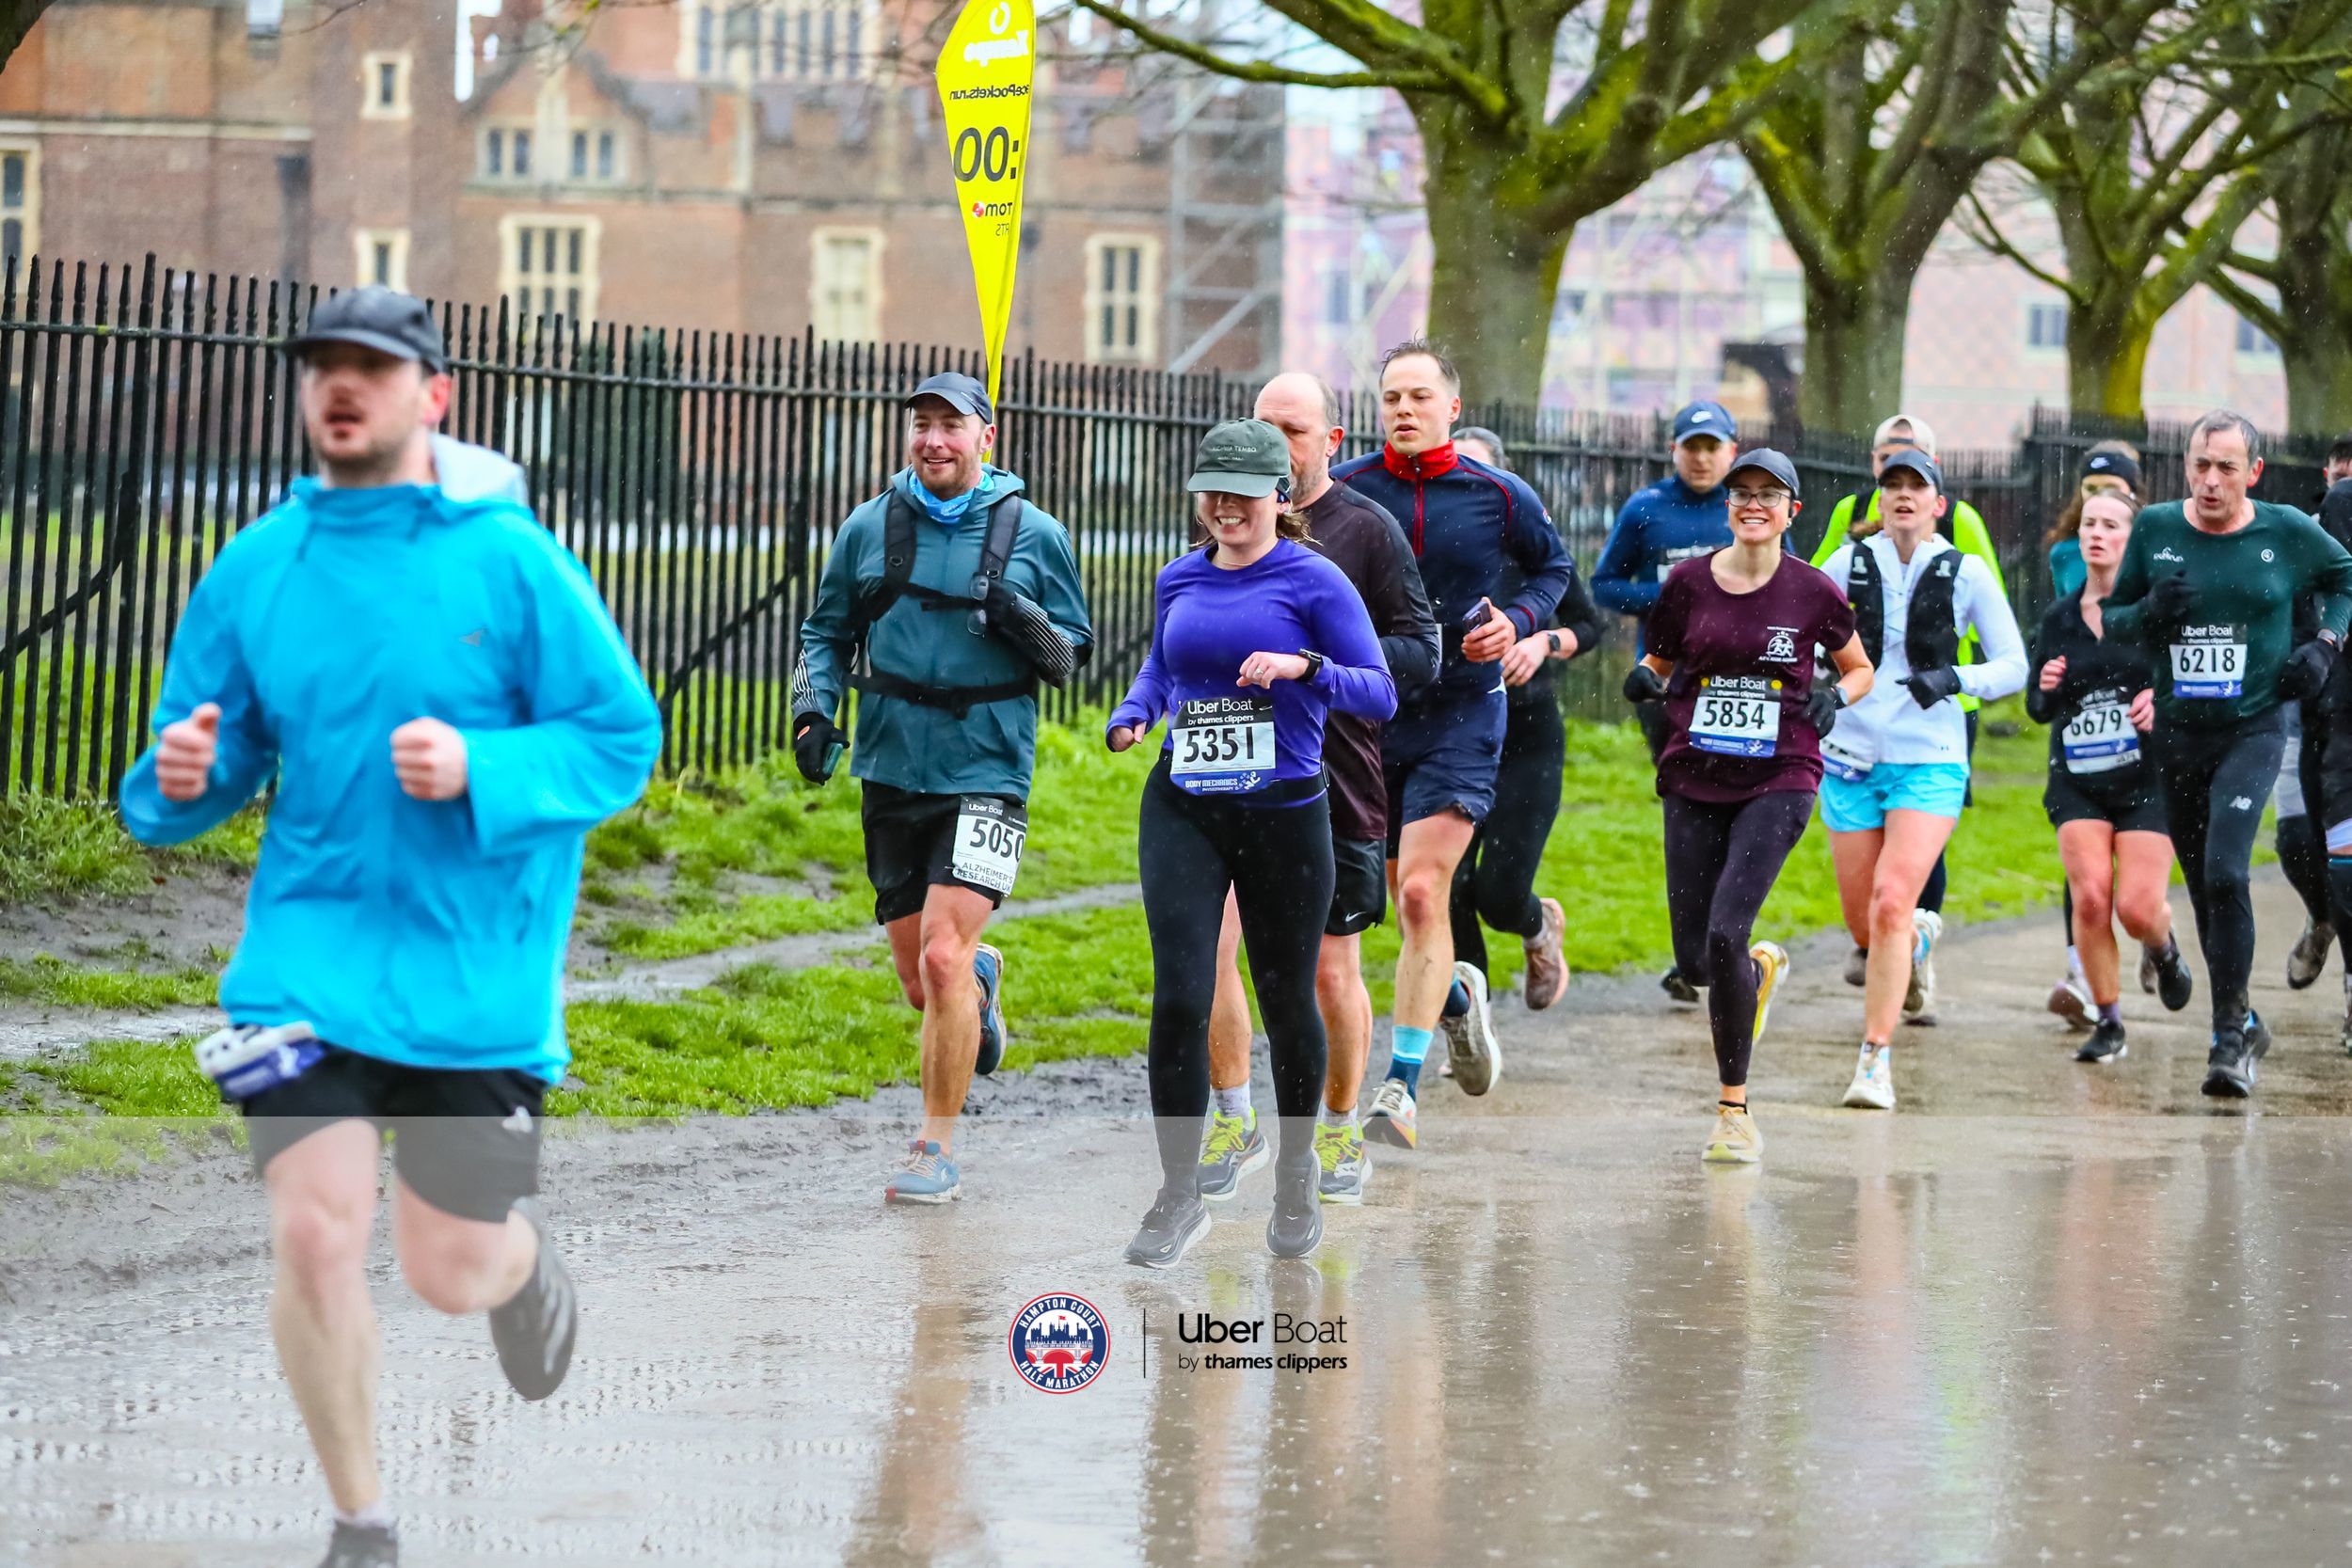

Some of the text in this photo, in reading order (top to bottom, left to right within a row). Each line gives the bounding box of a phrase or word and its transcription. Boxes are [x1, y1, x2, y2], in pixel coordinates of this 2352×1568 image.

[2181, 626, 2233, 637] Uber Boat
[2180, 647, 2235, 673] 6218
[1710, 675, 1766, 690] Uber Boat
[1187, 698, 1253, 715] Uber Boat
[1702, 700, 1765, 730] 5854
[1197, 716, 1223, 724] thames
[1224, 714, 1254, 724] clippers
[1183, 726, 1254, 763] 5351
[1185, 780, 1202, 788] BODY
[968, 803, 1004, 816] Uber Boat
[969, 818, 1025, 863] 5050
[957, 868, 1011, 893] RESEARCH UK
[961, 862, 1013, 884] ALZHEIMER'S
